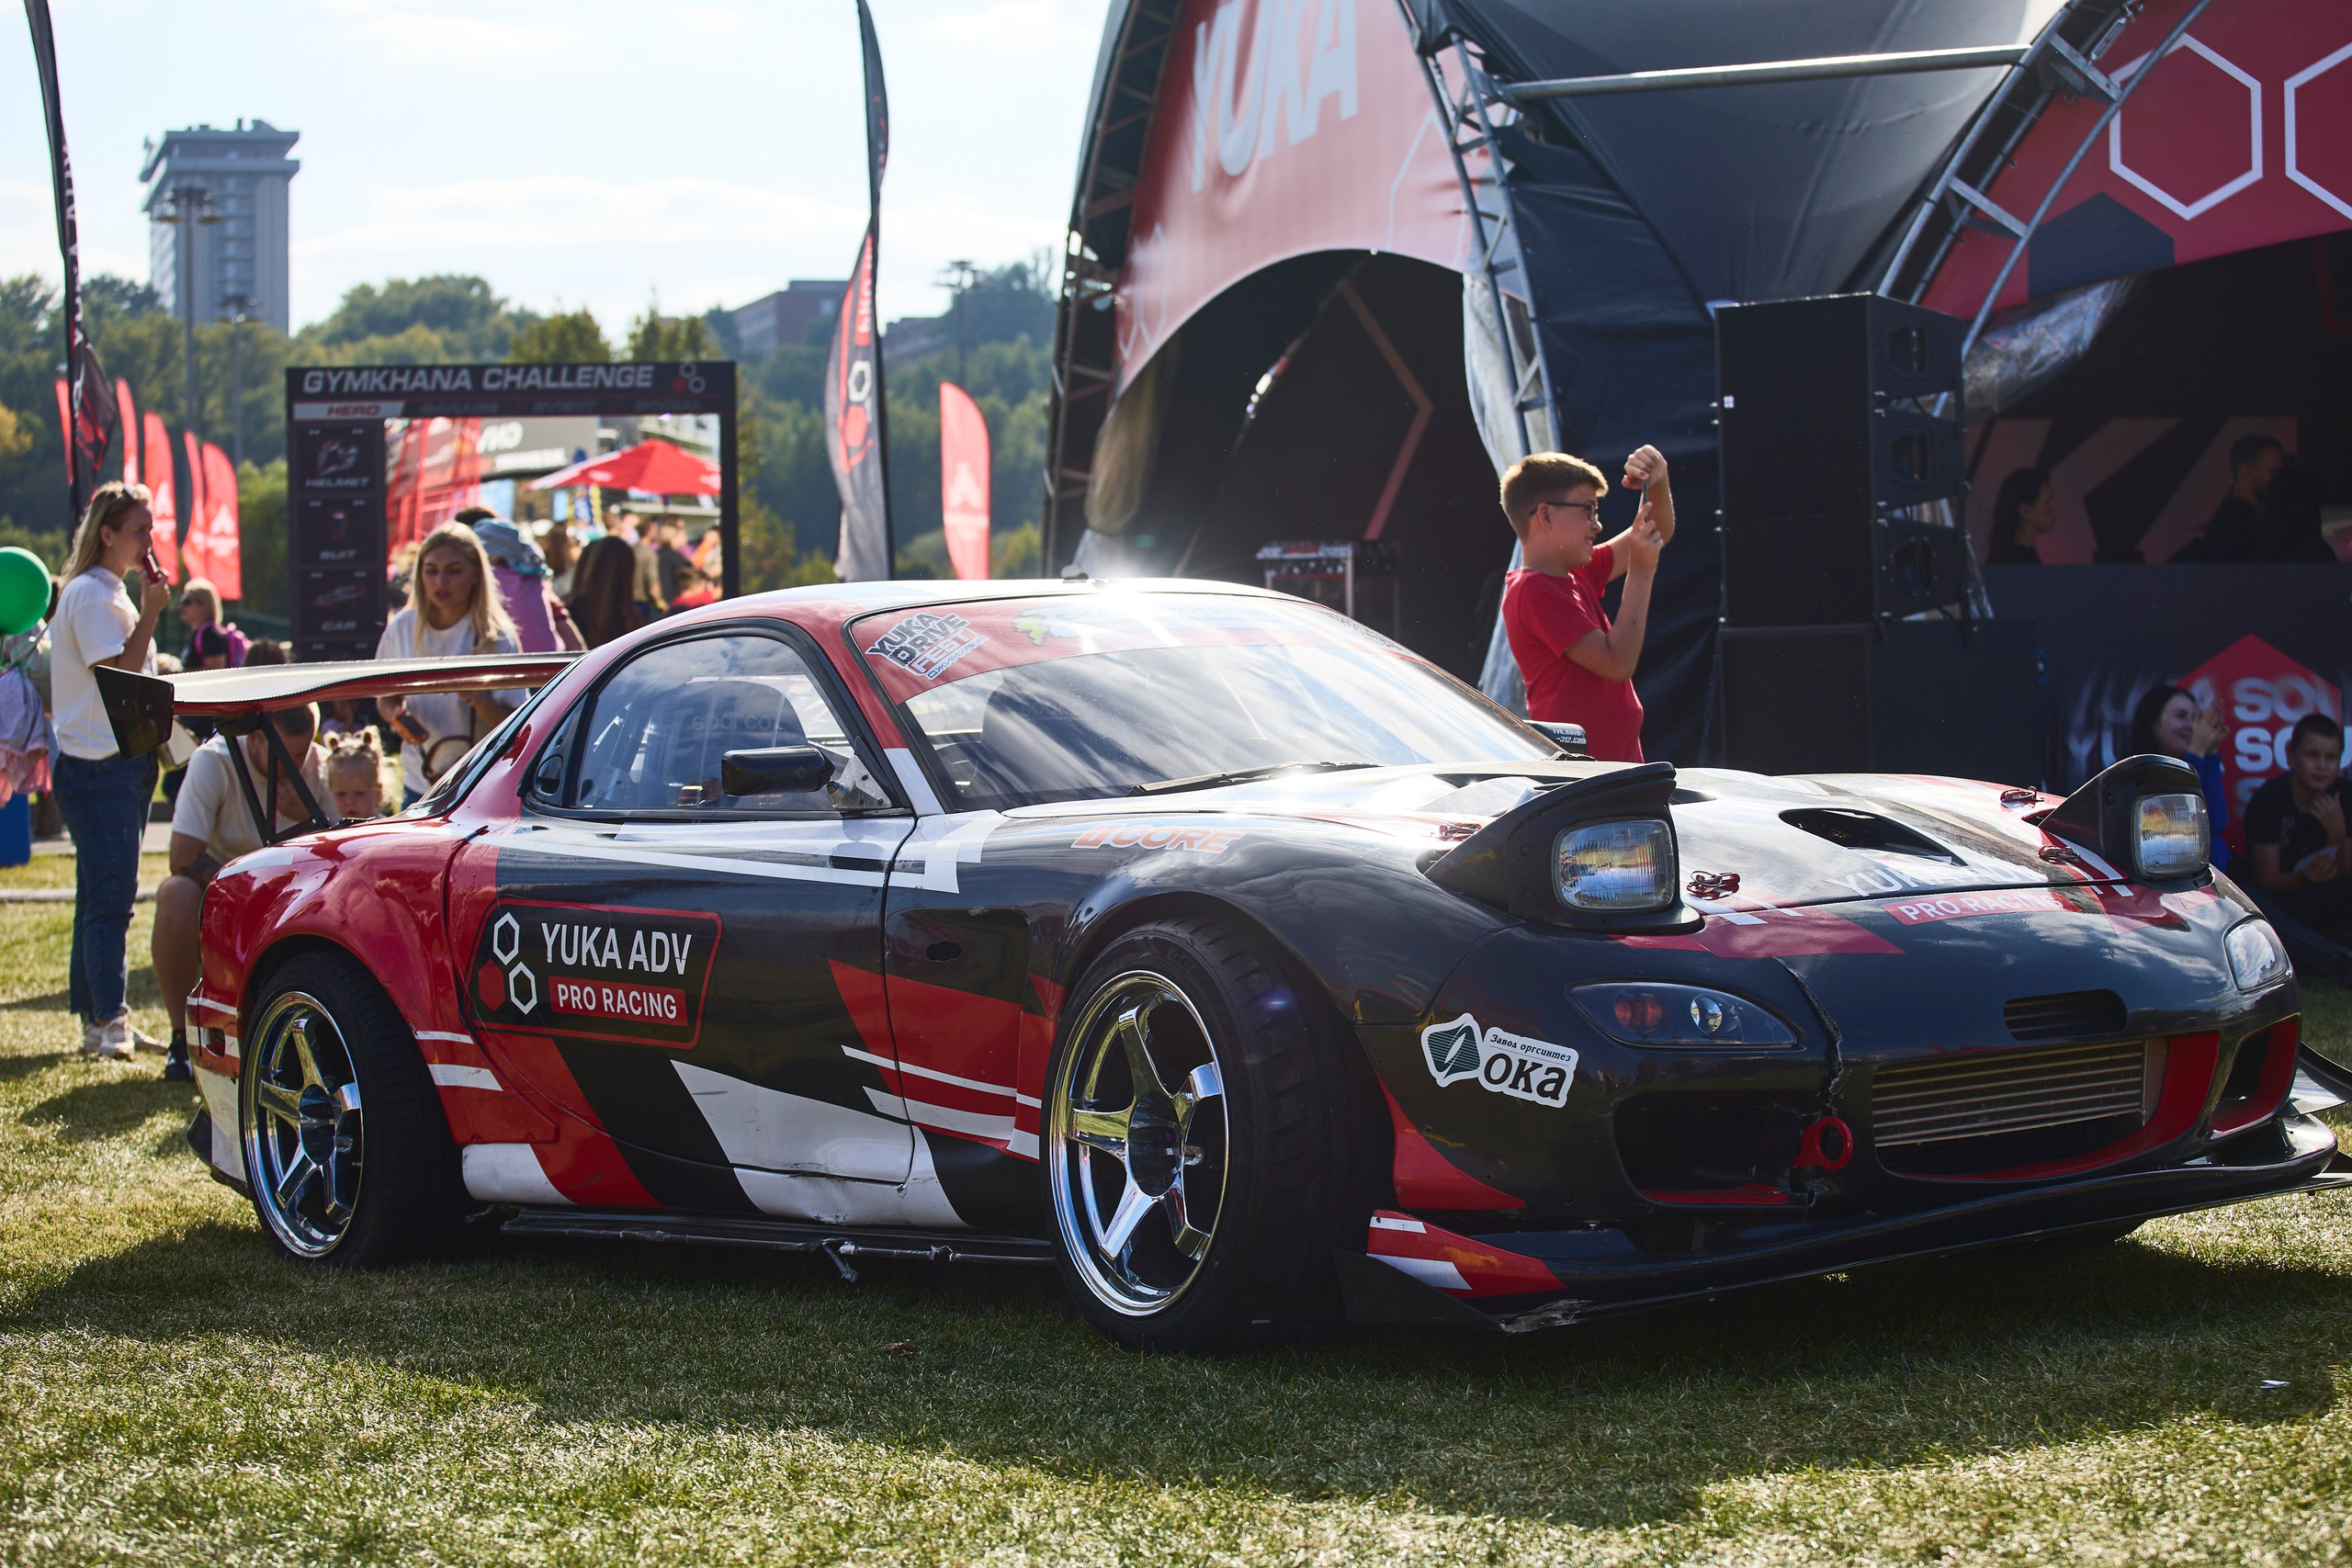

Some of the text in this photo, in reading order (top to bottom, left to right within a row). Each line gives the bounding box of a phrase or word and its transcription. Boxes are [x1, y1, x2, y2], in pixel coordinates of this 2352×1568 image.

[1192, 0, 1359, 194] YUKA
[302, 365, 654, 393] GYMKHANA CHALLENGE
[327, 405, 381, 416] HERO
[305, 477, 371, 488] HELMET
[322, 621, 356, 632] CAR
[869, 614, 940, 656] YUKA
[888, 615, 968, 667] DRIVE
[911, 630, 971, 672] FEST
[692, 713, 773, 731] sparco
[1826, 856, 1962, 897] YUKA
[1898, 894, 2064, 920] PRO RACING
[541, 922, 693, 976] YUKA ADV
[557, 984, 677, 1020] PRO RACING
[1490, 1034, 1572, 1062] Завод оргсинтез
